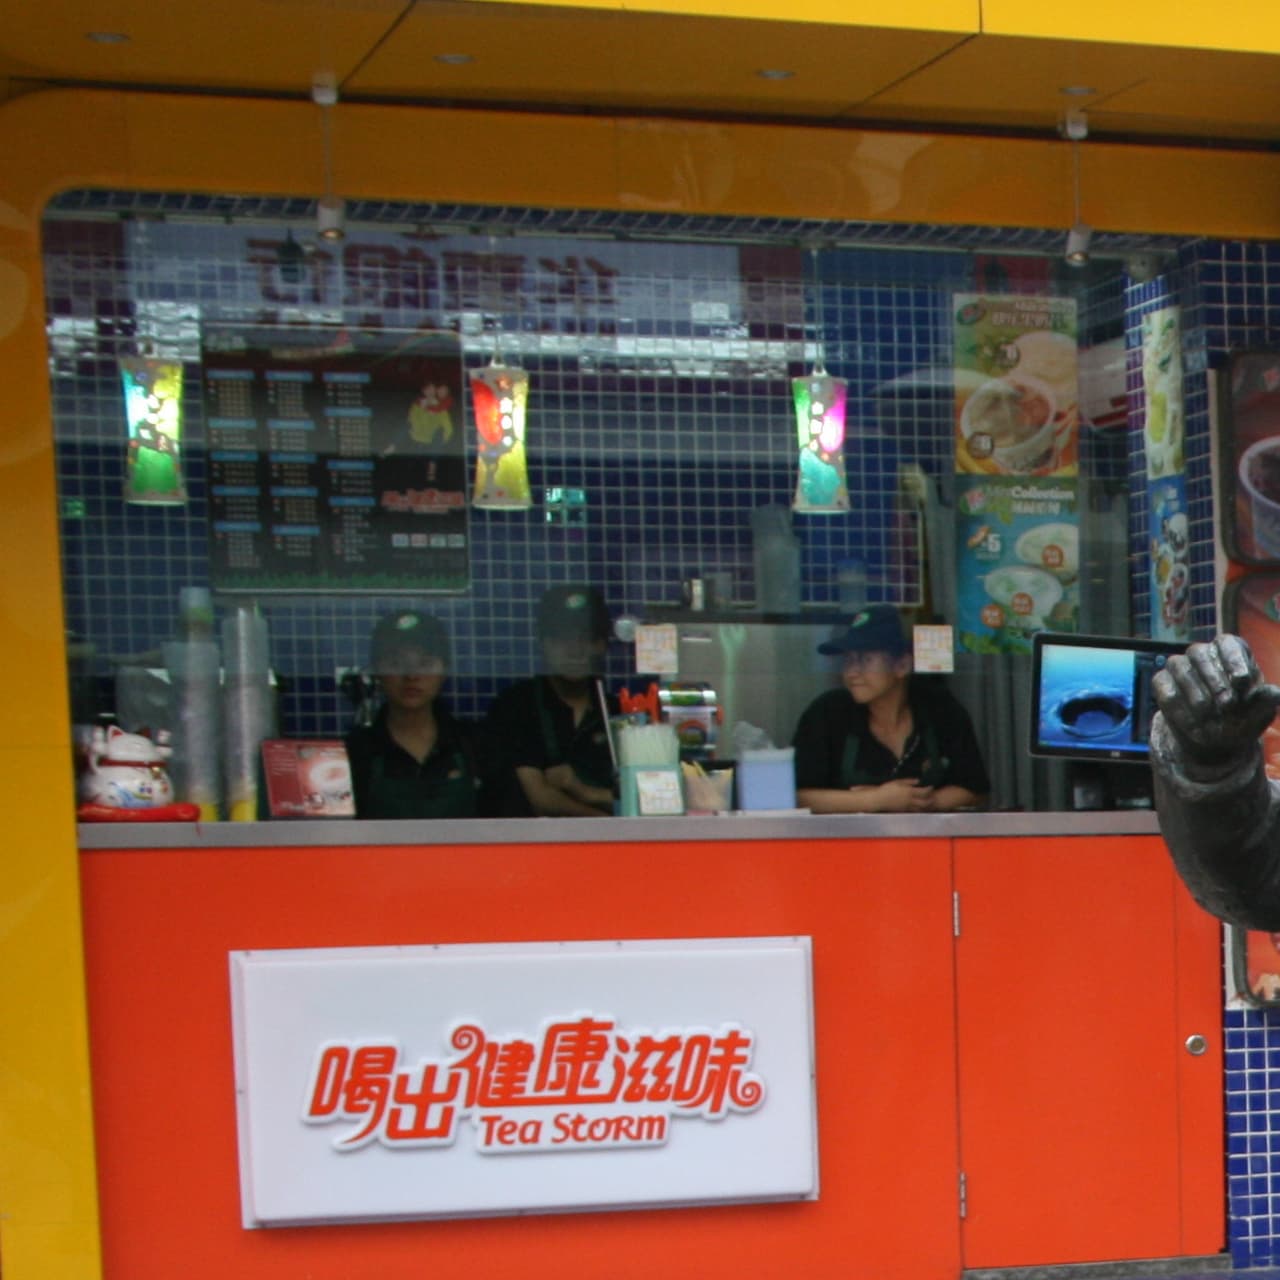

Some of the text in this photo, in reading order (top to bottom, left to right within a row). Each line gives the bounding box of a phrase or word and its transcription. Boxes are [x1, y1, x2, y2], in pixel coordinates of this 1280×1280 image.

[308, 1017, 764, 1145] 喝出健康滋味
[479, 1115, 543, 1147] Tea
